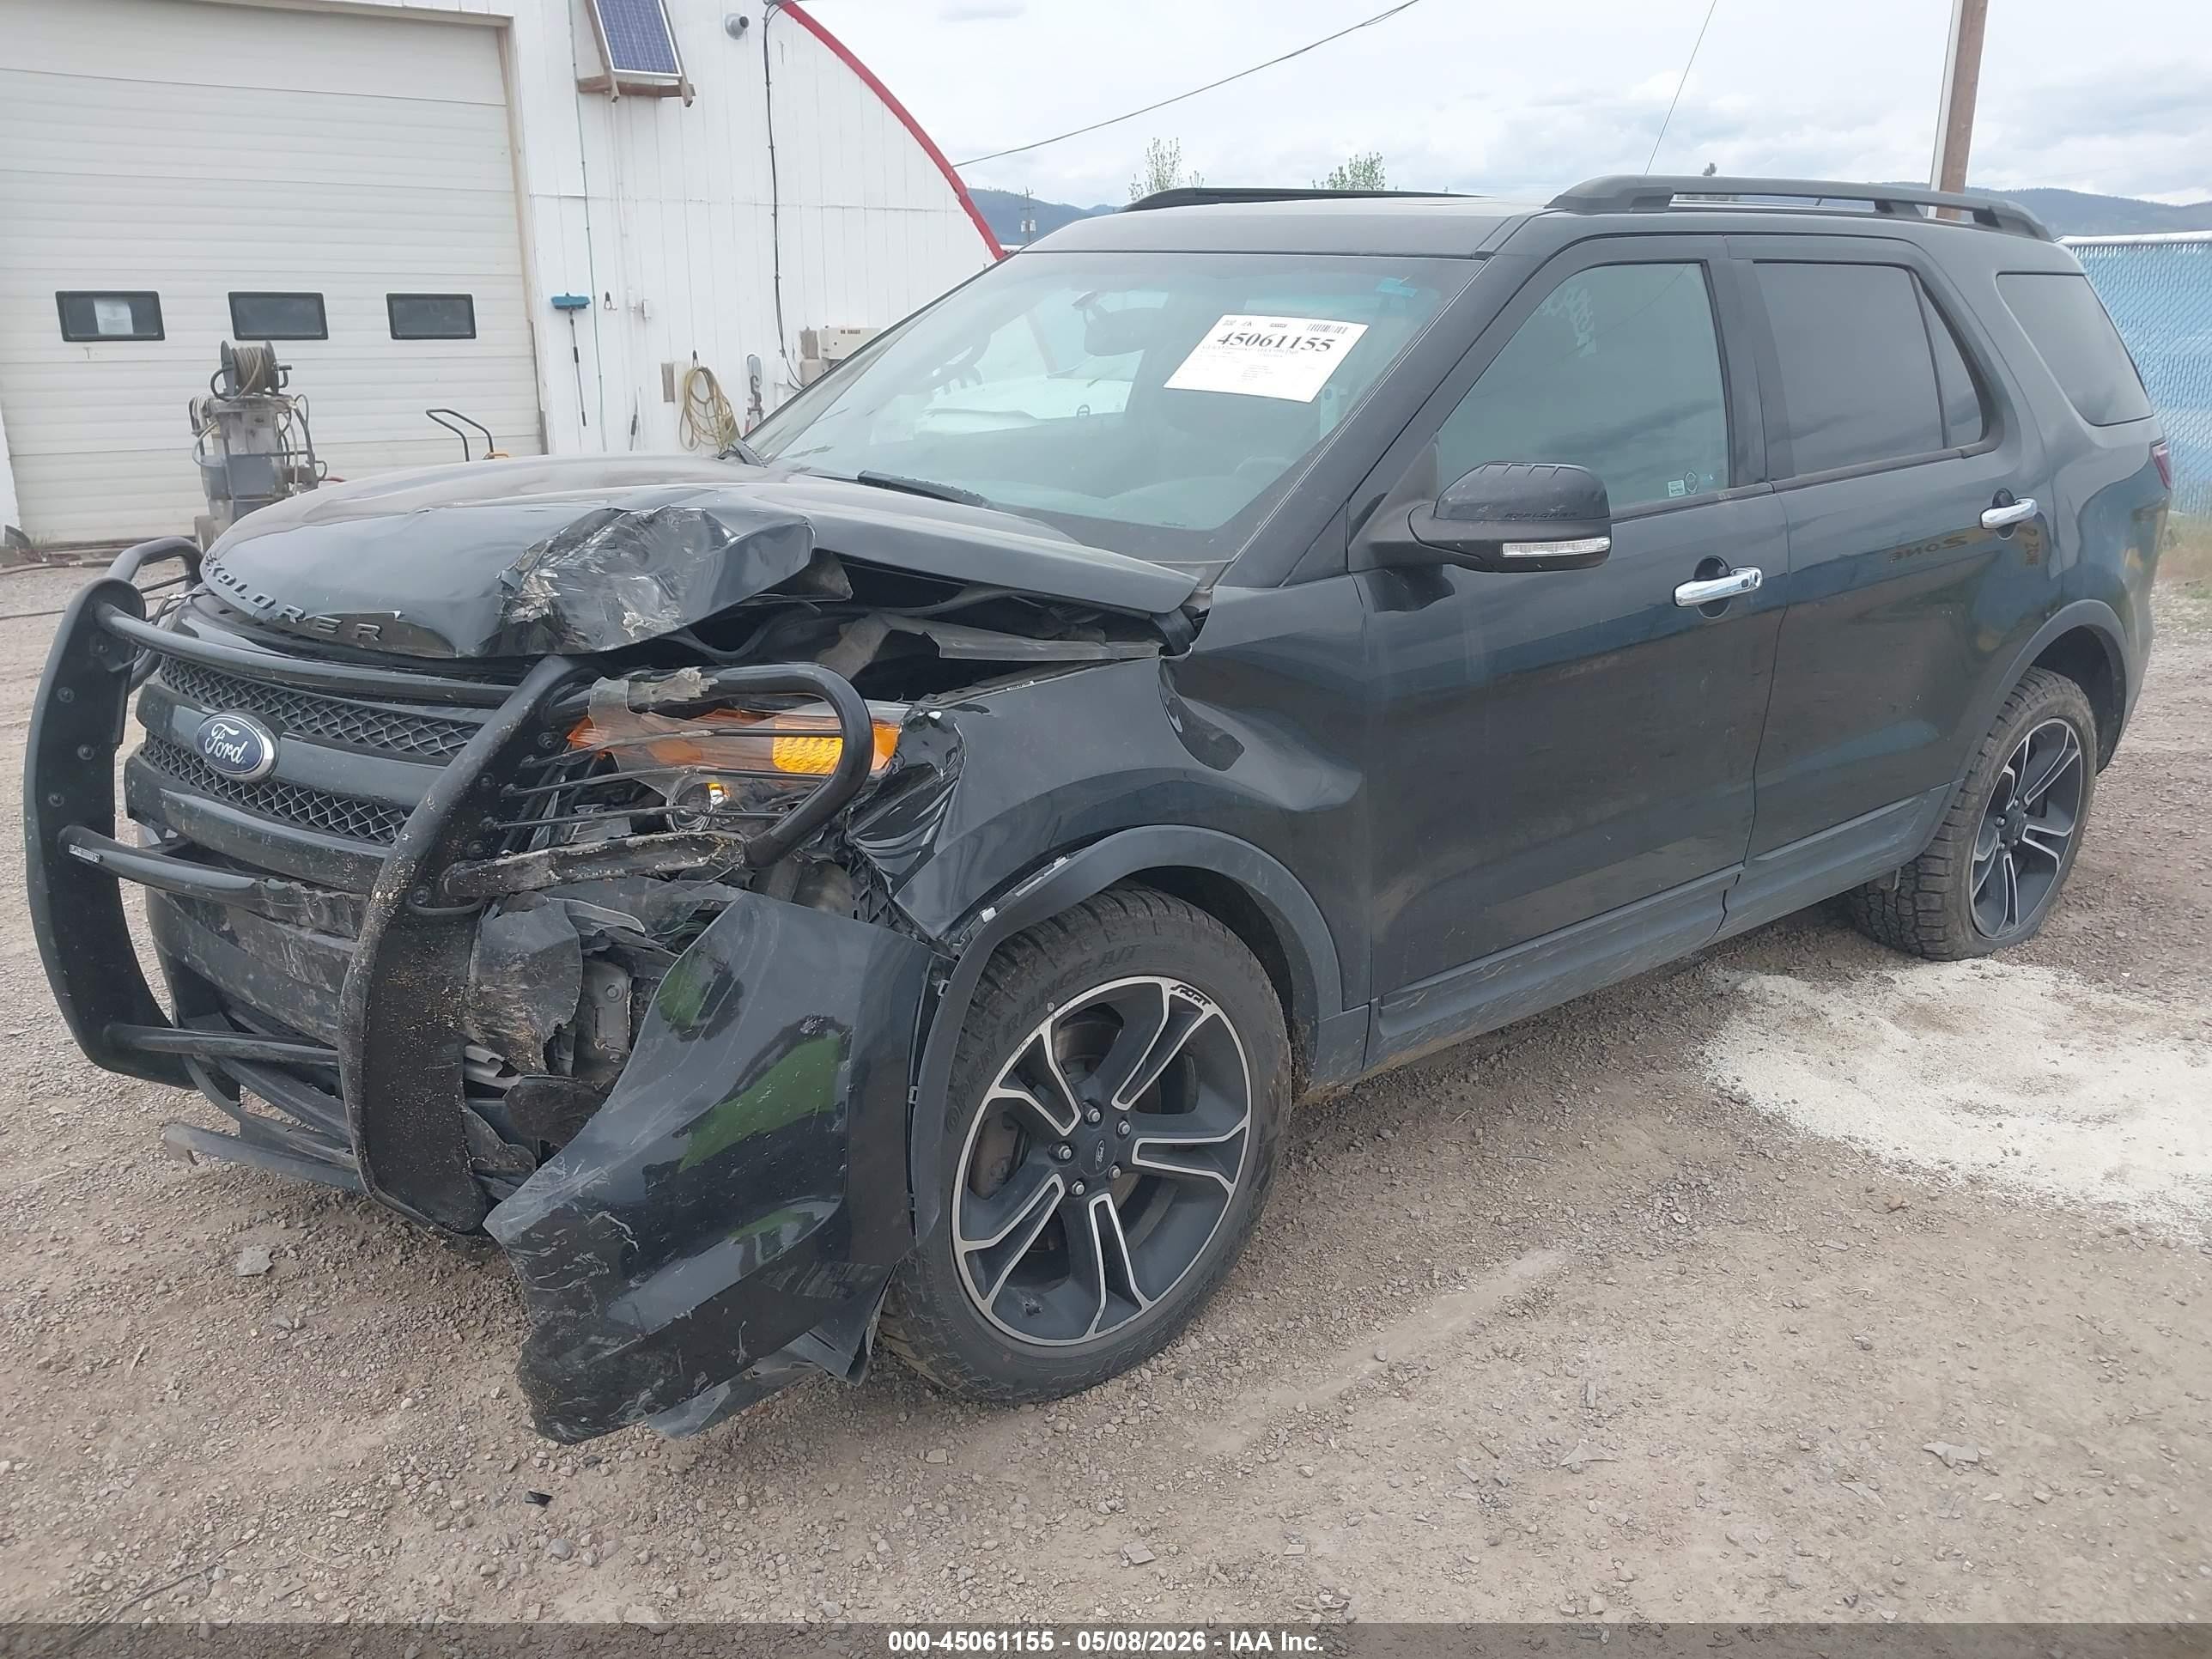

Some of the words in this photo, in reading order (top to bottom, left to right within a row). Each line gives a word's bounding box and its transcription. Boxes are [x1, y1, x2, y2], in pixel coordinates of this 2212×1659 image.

[1217, 331, 1336, 354] 45061155
[204, 722, 249, 765] Ford
[1170, 983, 1212, 1006] SPORT
